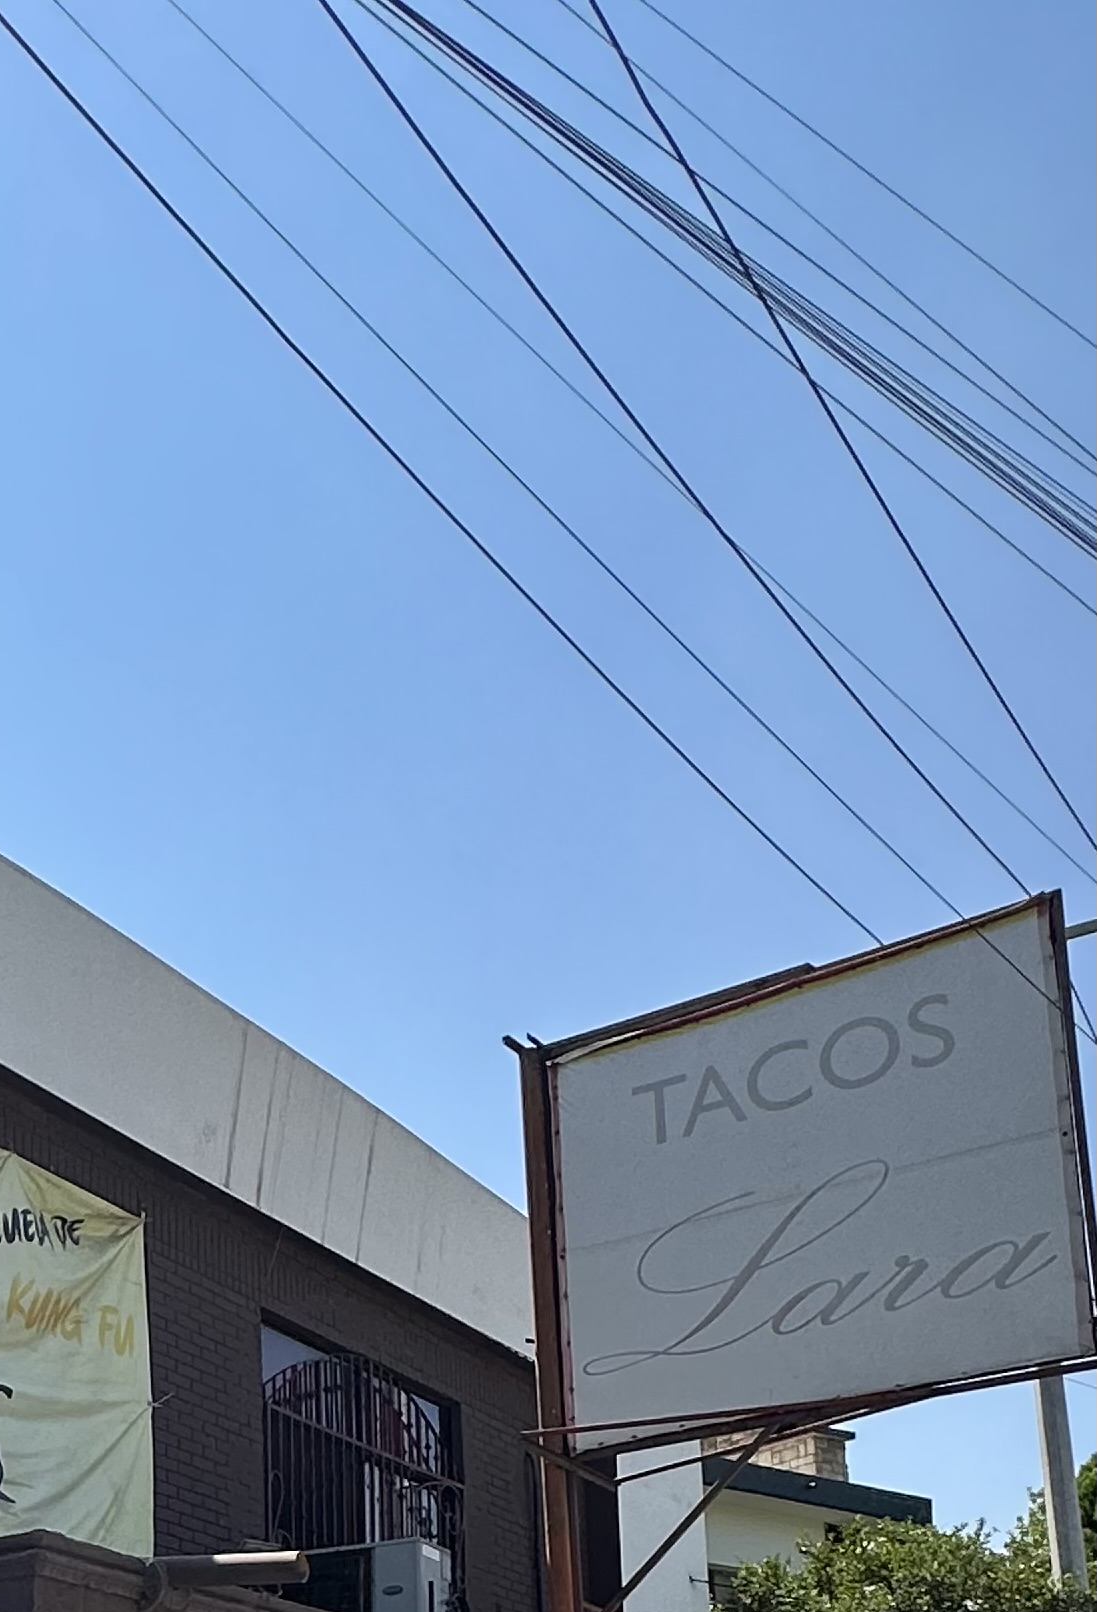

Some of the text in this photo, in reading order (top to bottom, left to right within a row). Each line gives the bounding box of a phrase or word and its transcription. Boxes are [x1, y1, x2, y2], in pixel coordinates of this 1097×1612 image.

[631, 993, 955, 1146] TACOS
[50, 1214, 86, 1252] DE
[582, 1158, 1058, 1377] Lara
[6, 1271, 135, 1358] KUNG FU
